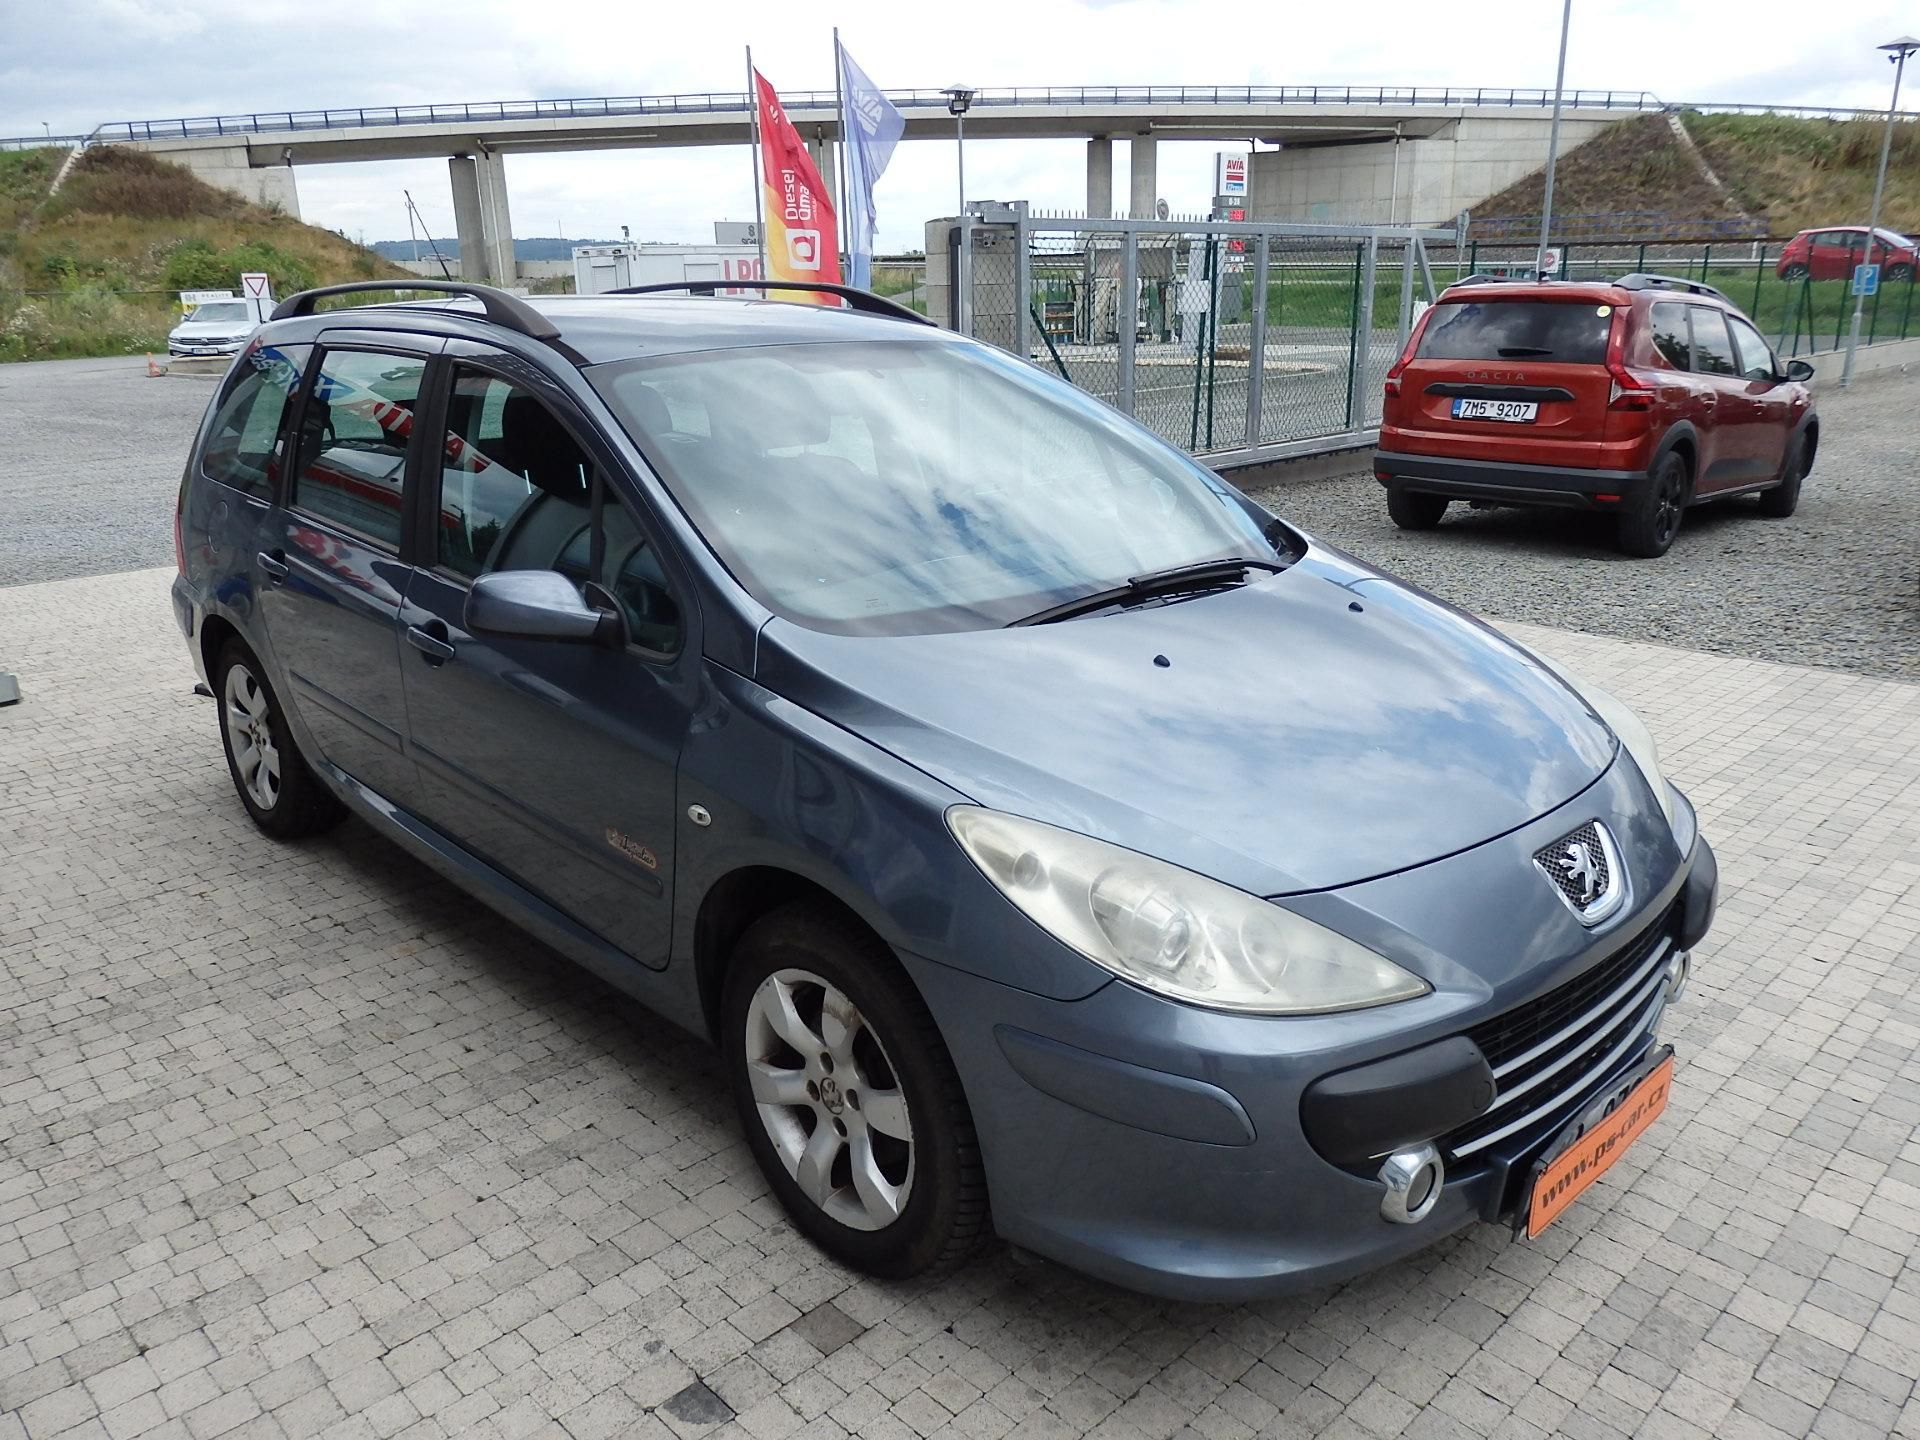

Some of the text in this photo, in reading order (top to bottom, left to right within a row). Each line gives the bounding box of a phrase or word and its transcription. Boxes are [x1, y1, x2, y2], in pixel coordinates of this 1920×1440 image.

[782, 169, 798, 220] Diesel
[798, 182, 811, 221] Qma
[1467, 371, 1525, 381] DACIA
[1463, 401, 1530, 418] 7M5 9207
